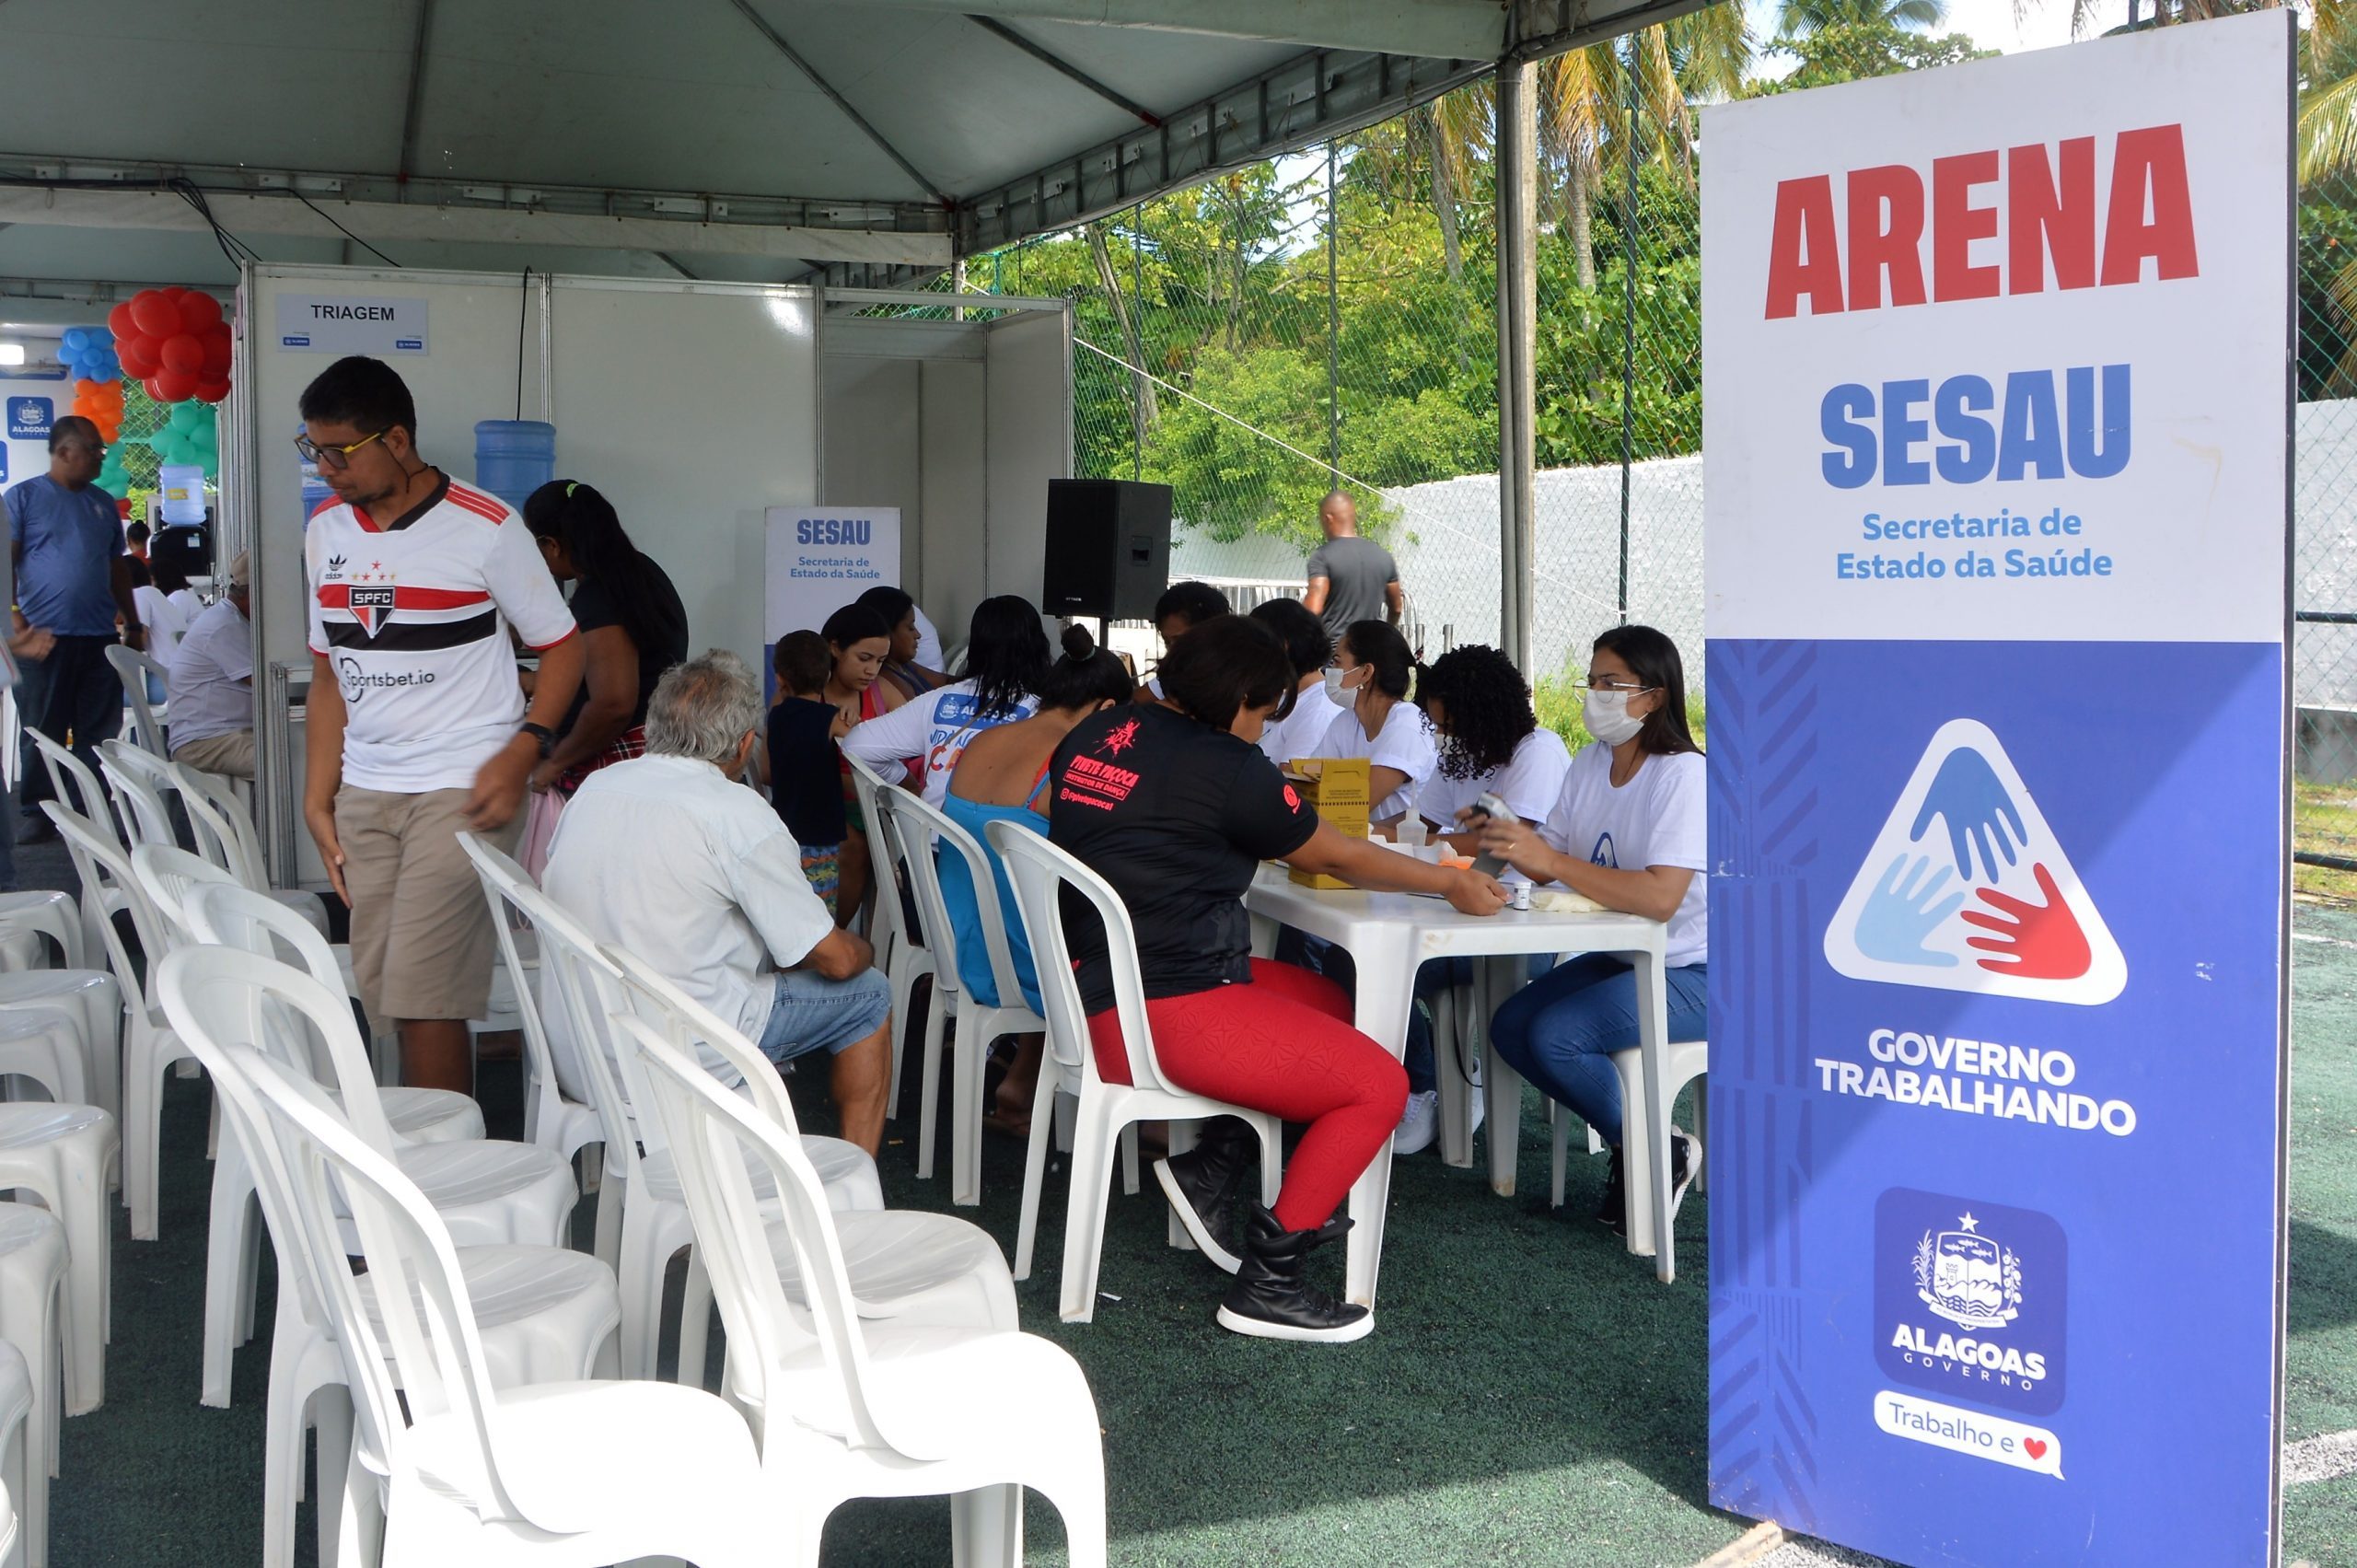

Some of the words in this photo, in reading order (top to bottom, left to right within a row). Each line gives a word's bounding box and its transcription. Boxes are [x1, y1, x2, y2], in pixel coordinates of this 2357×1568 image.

[1764, 123, 2199, 319] ARENA
[310, 305, 395, 320] TRIAGEM
[1820, 364, 2131, 489] SESAU
[797, 519, 871, 545] SESAU
[1863, 509, 2030, 540] Secretaria
[2039, 507, 2082, 537] de
[790, 568, 828, 578] Estado
[830, 569, 844, 578] da
[846, 568, 881, 579] Saúde
[798, 556, 853, 567] Secretaria
[856, 558, 870, 567] de
[1836, 551, 1946, 579] Estado
[1955, 551, 1996, 578] da
[2003, 548, 2113, 577] Saúde
[354, 592, 391, 604] SPFC
[345, 669, 435, 689] Sportsbet.io
[1065, 772, 1096, 787] INSTRUTOR
[1095, 781, 1104, 789] DE
[1103, 784, 1126, 797] DANÇA
[1070, 755, 1104, 774] PIVETE
[1098, 764, 1140, 788] PAÇOCA
[1868, 1028, 2076, 1086] GOVERNO
[1815, 1058, 2137, 1136] TRABALHANDO
[1891, 1323, 2047, 1380] ALAGOAS
[1903, 1353, 2033, 1391] GOVERNO
[1888, 1401, 1993, 1447] Trabalho
[2000, 1435, 2014, 1453] e
